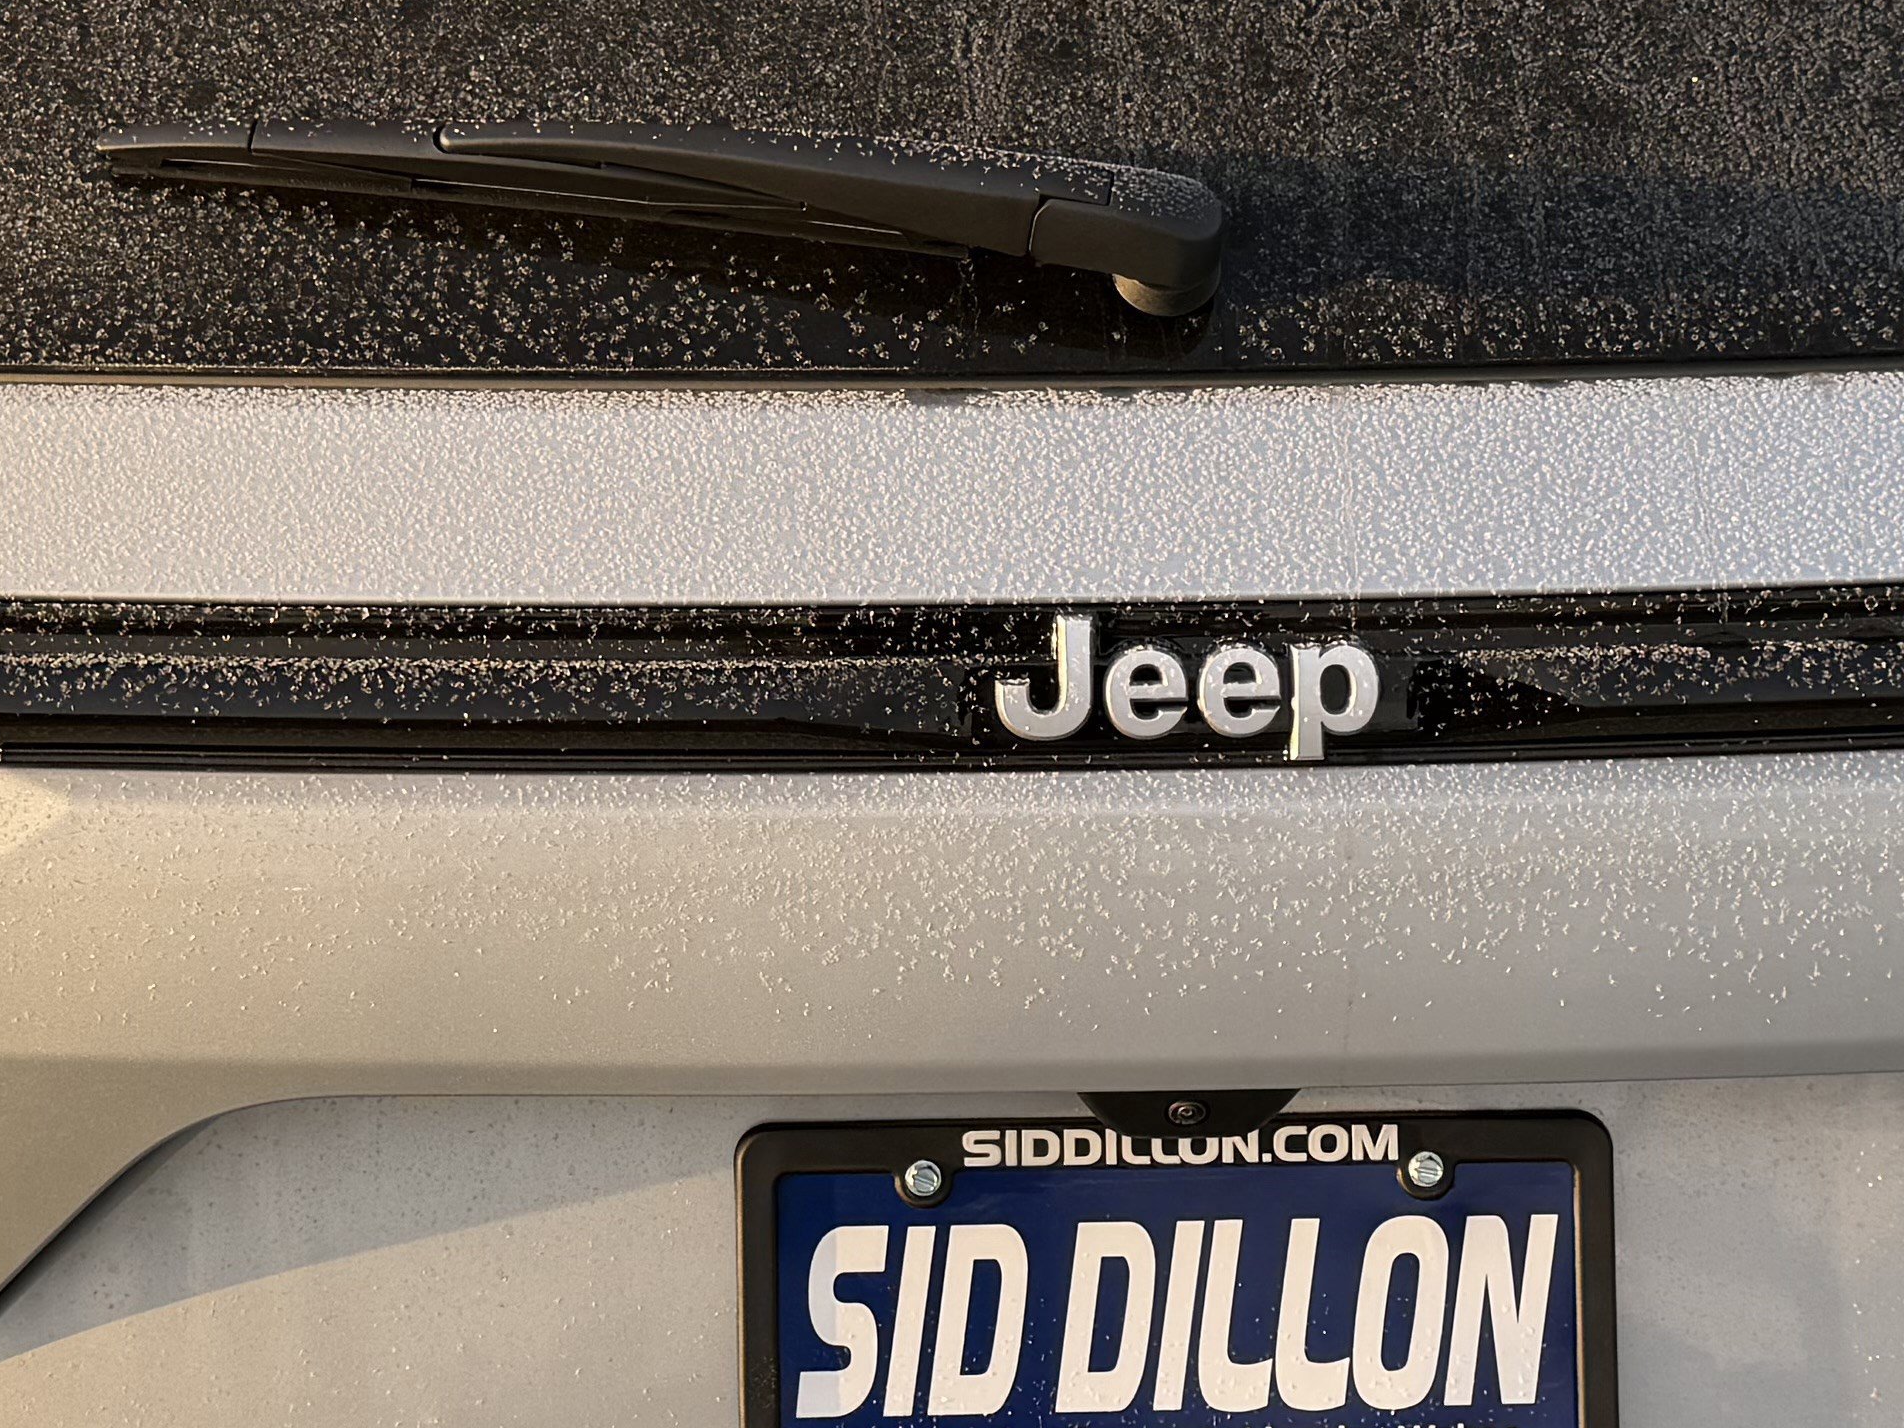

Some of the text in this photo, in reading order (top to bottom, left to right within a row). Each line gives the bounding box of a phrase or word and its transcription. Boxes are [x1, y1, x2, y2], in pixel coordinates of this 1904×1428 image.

[995, 615, 1380, 761] Jeep
[962, 1124, 1399, 1167] SIDDILLON.COM
[796, 1214, 1560, 1419] SID DILLON
